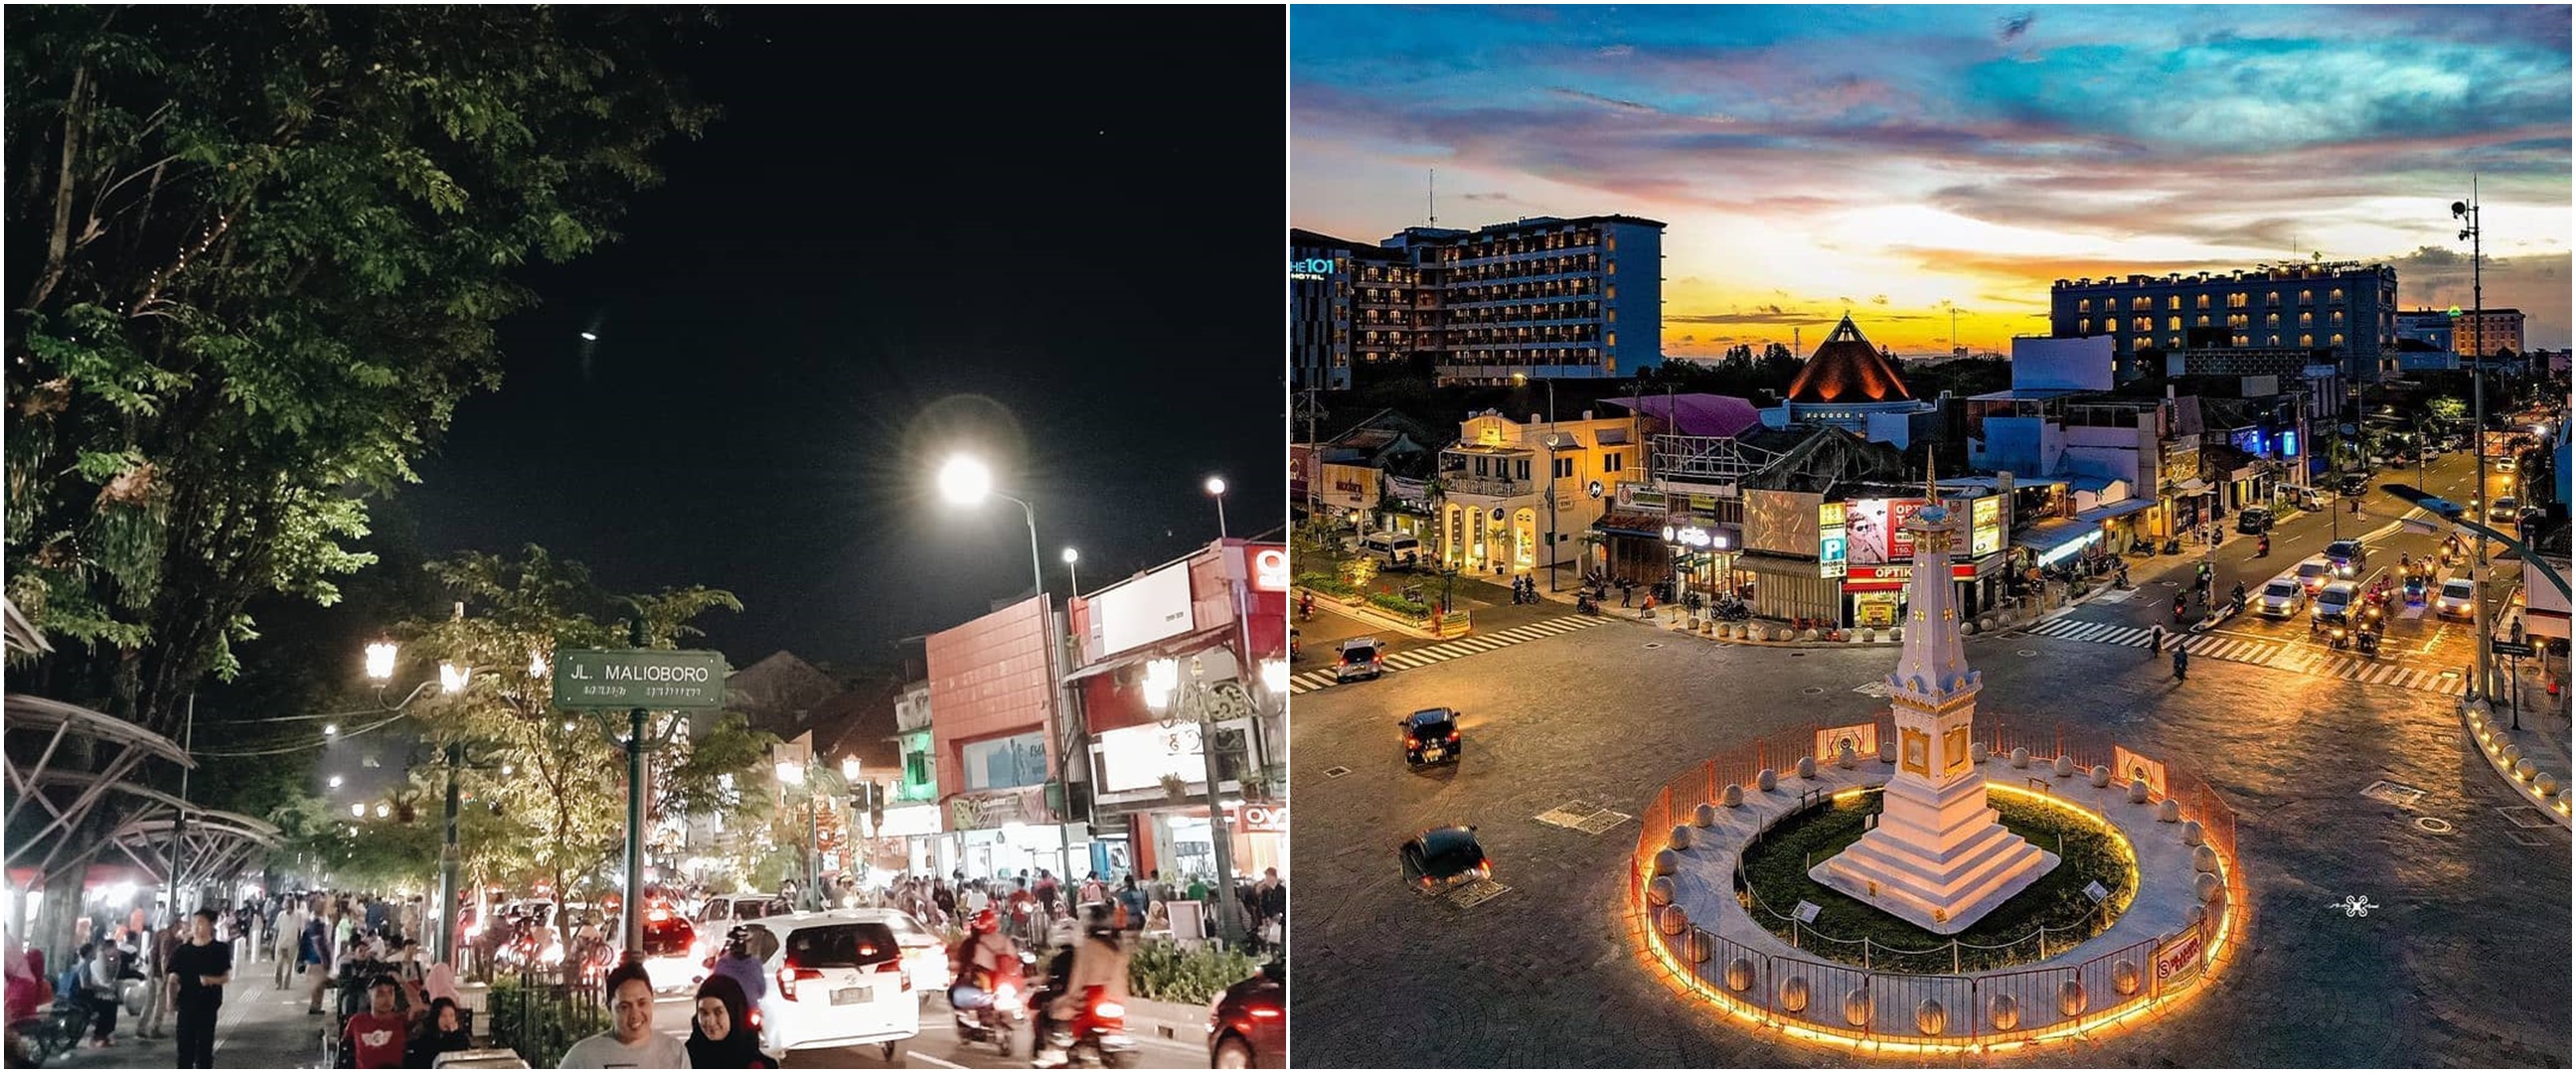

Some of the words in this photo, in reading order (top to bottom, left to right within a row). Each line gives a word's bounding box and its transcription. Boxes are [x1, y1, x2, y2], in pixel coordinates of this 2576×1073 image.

[1895, 505, 1921, 515] OPT
[1255, 549, 1286, 575] O
[1875, 568, 1912, 578] OPTIK
[570, 664, 593, 680] JL.
[605, 664, 709, 683] MALIOBORO
